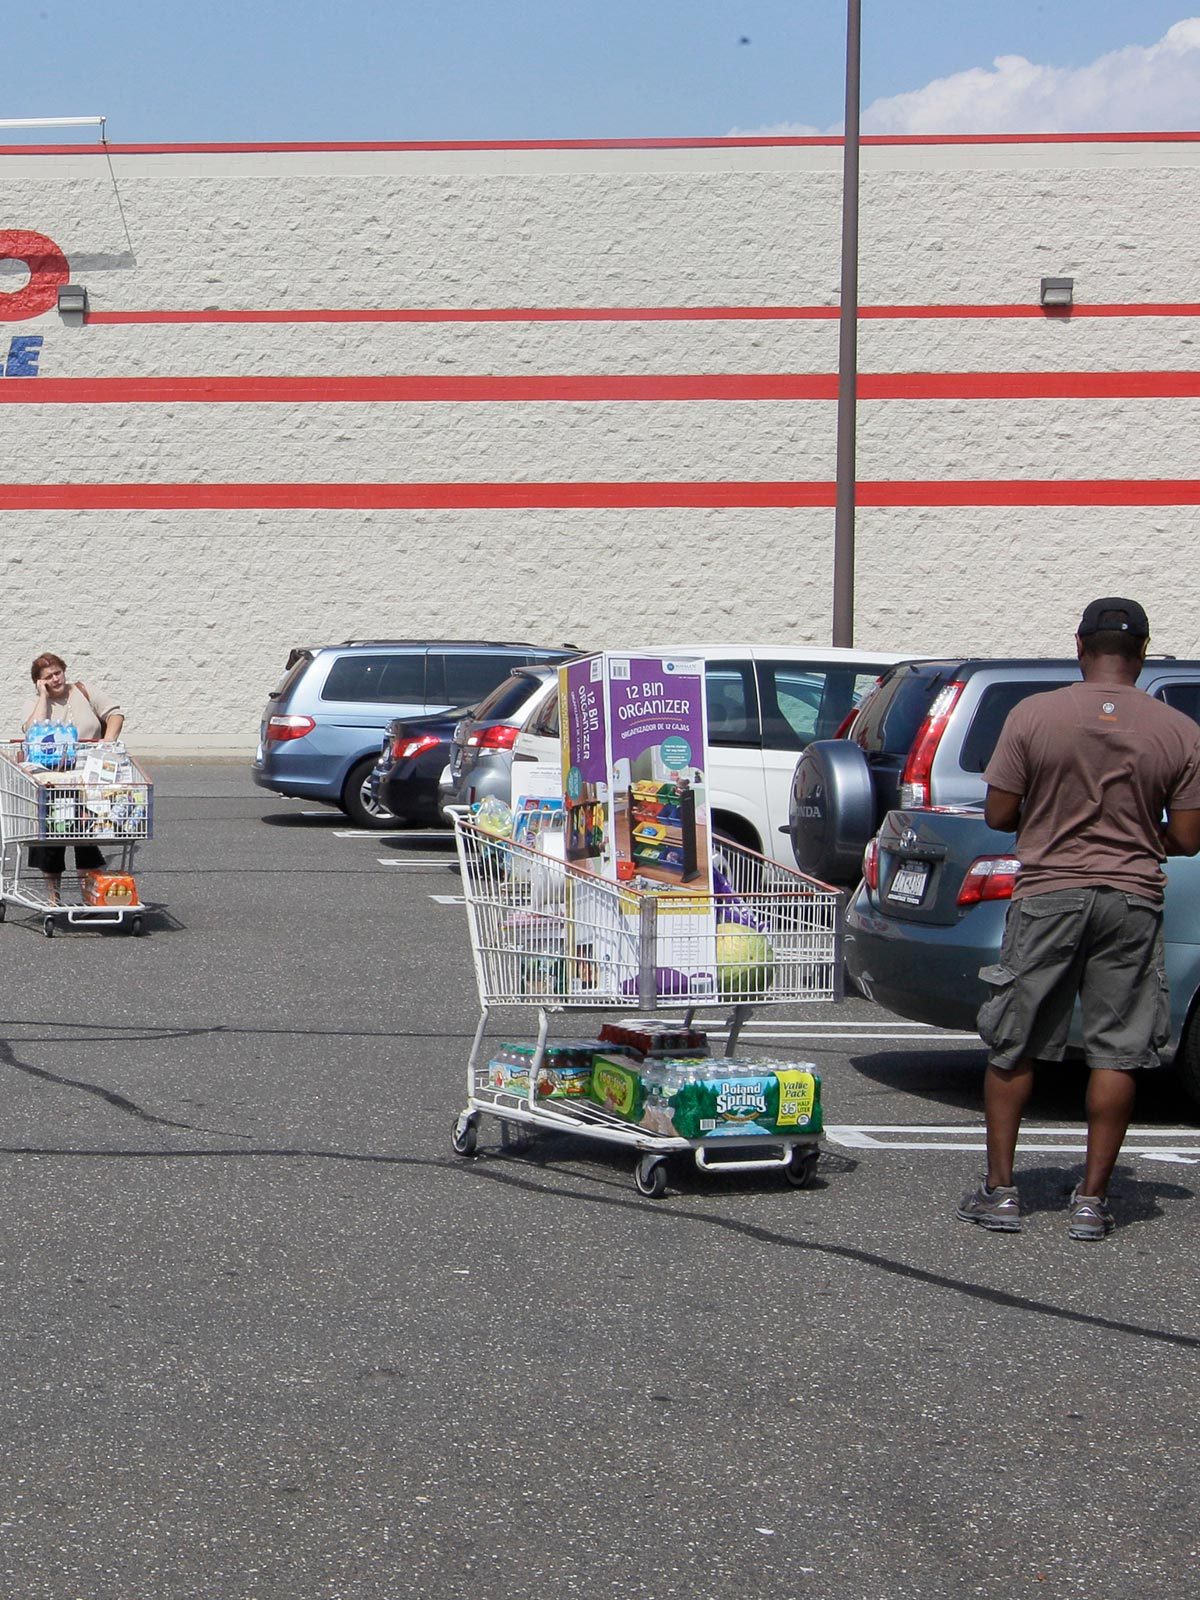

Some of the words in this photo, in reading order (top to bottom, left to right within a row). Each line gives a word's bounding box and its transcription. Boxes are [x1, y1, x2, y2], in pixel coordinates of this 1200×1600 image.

[588, 690, 596, 704] 12
[626, 685, 639, 699] 12
[618, 699, 690, 720] ORGANIZER
[578, 685, 590, 760] ORGANIZER
[621, 723, 656, 739] ORGANIZADOR
[672, 723, 690, 732] CAJAS
[722, 1082, 761, 1094] Poland
[783, 1081, 808, 1090] Value
[785, 1090, 807, 1098] Pack
[716, 1093, 767, 1113] Spring
[781, 1101, 797, 1115] 35
